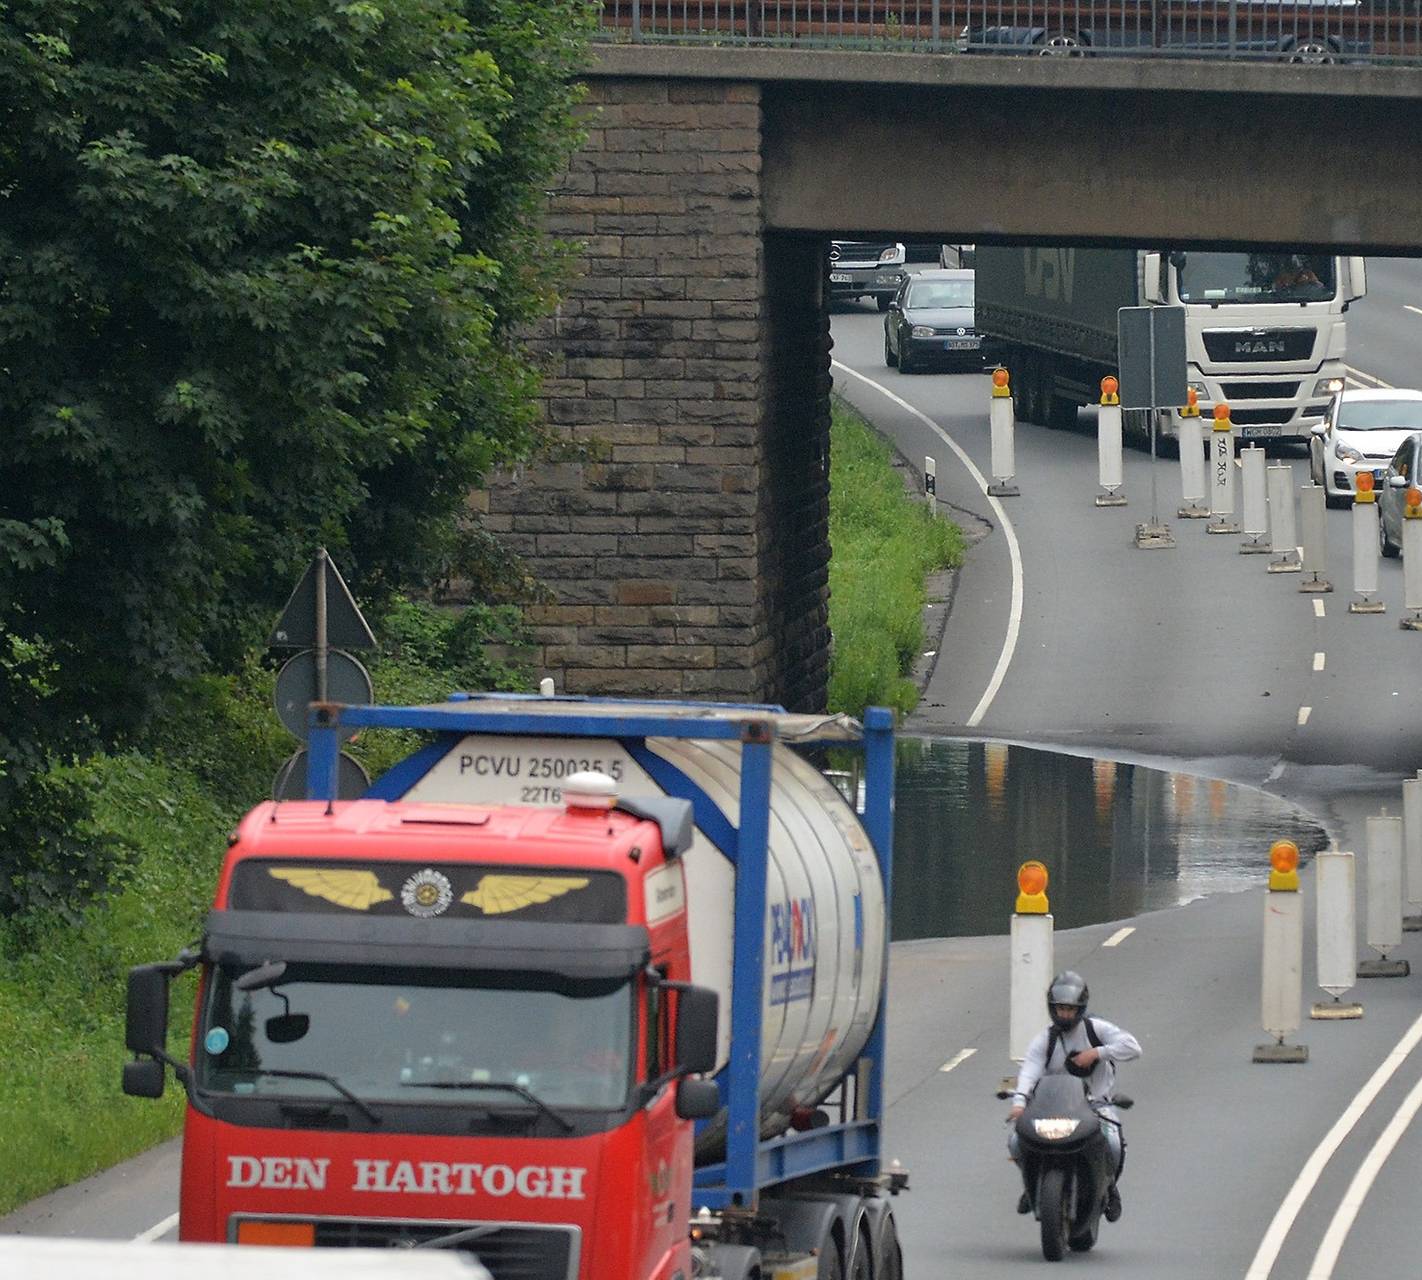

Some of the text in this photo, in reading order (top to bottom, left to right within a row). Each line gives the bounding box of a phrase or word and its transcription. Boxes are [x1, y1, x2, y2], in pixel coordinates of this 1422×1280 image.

[1235, 341, 1285, 353] MAN
[460, 754, 520, 777] PCVU
[226, 1156, 587, 1199] DEN HARTOGH
